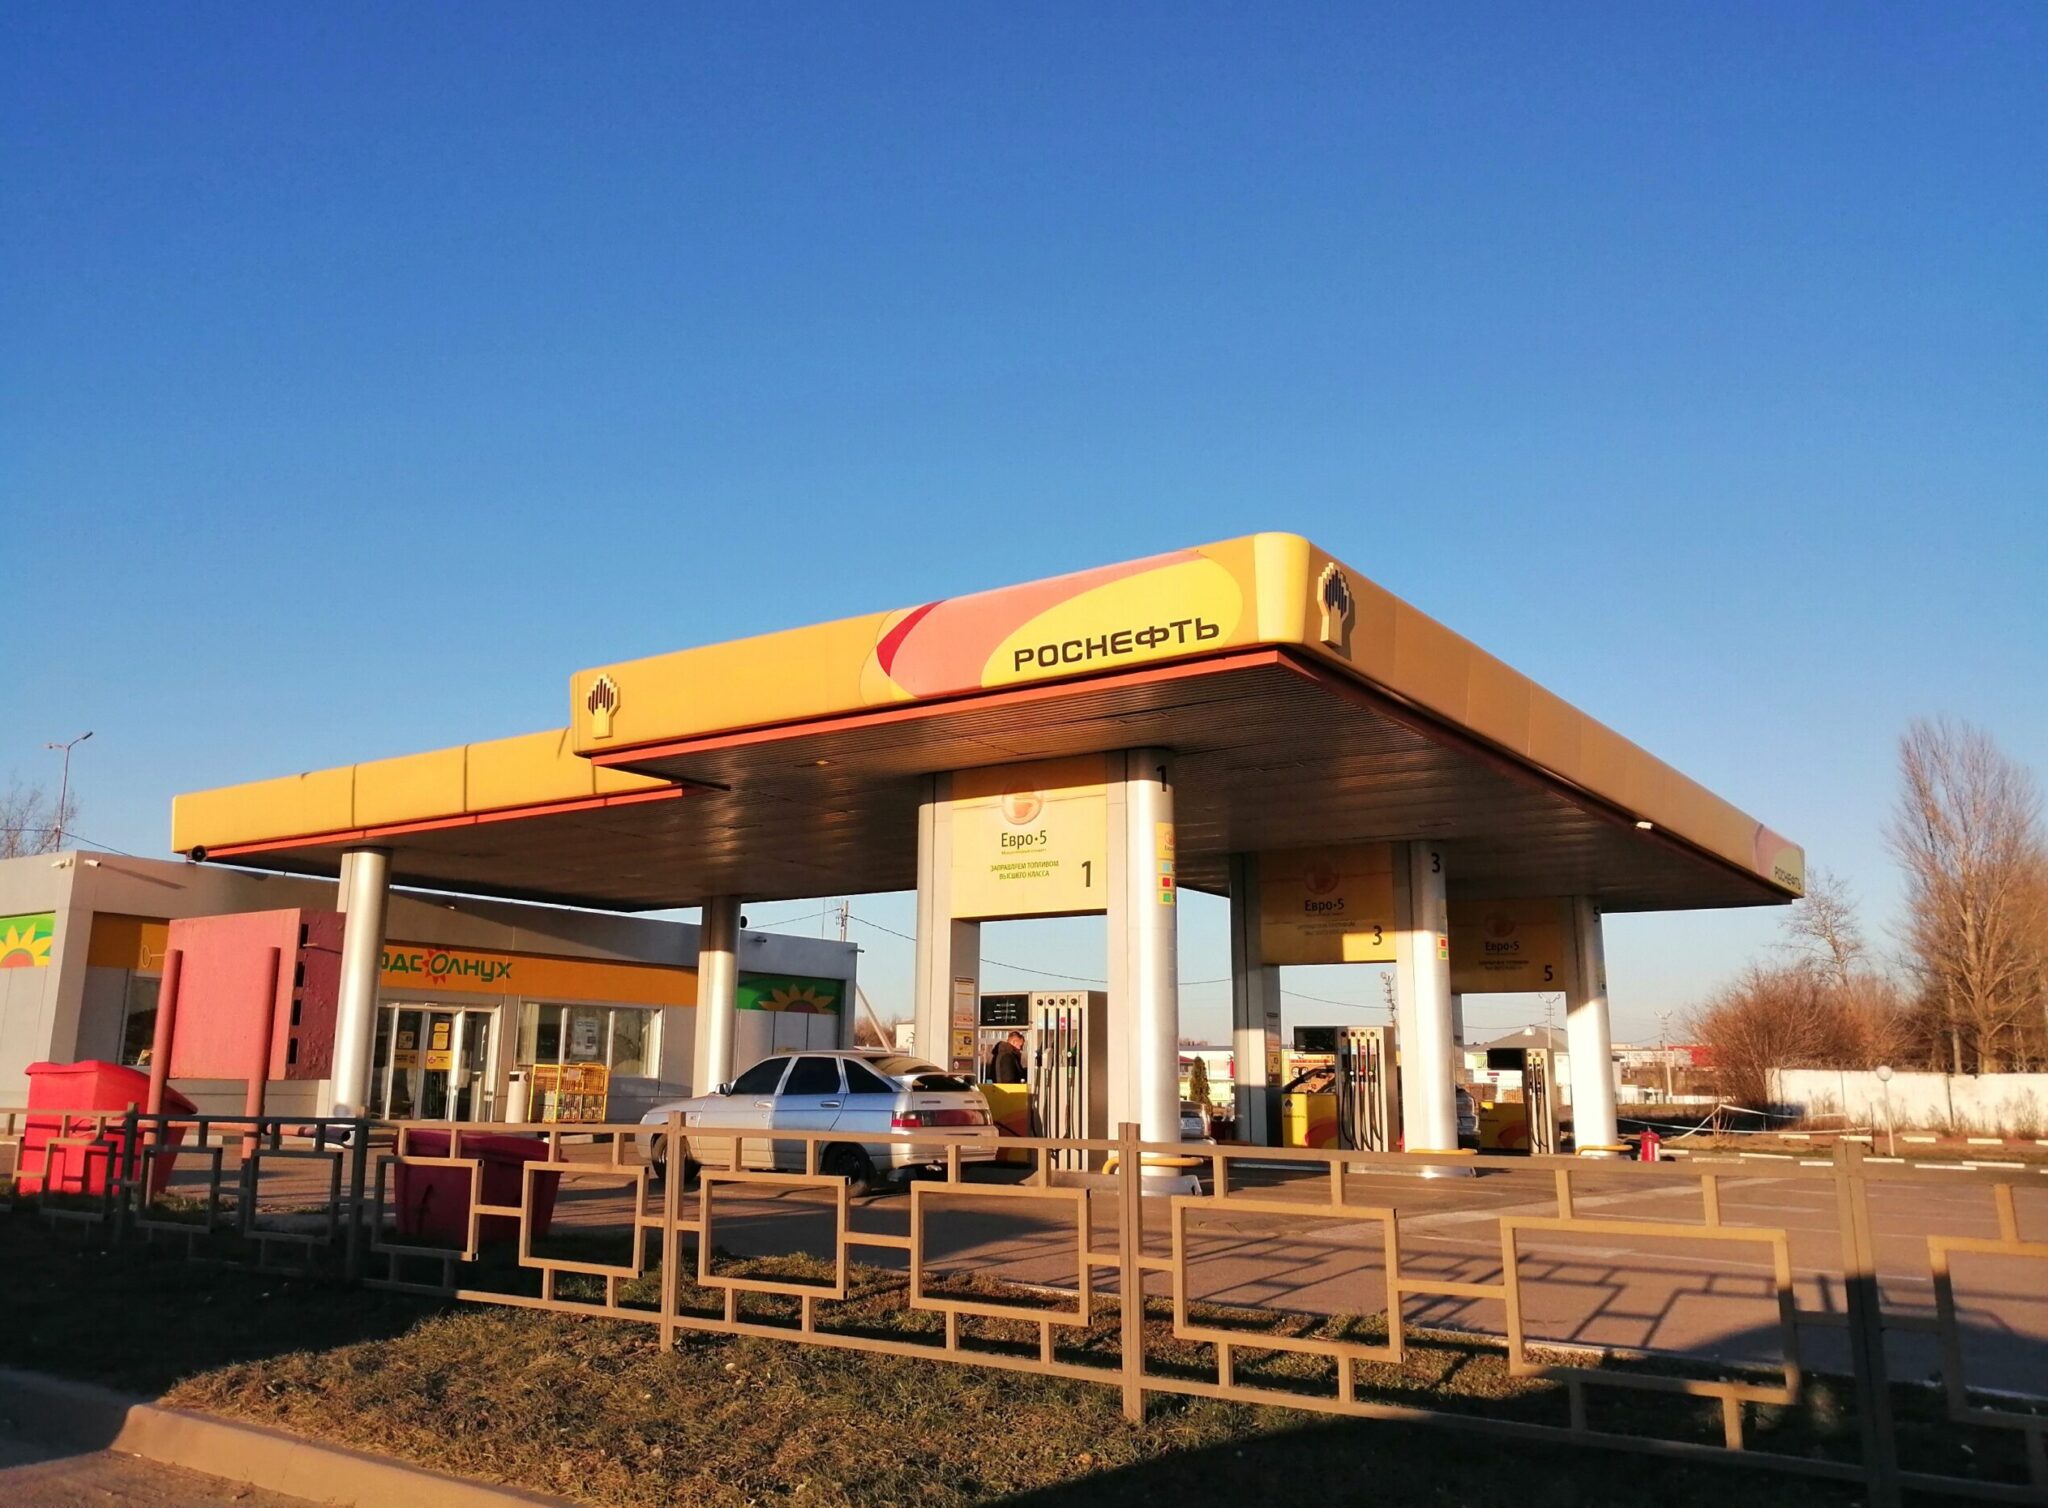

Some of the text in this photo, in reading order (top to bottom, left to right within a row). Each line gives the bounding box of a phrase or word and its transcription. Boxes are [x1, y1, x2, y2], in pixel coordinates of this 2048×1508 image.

[1014, 617, 1219, 672] РОСНЕФТЬ
[1156, 765, 1167, 792] 1
[1081, 860, 1092, 887] 1
[1431, 852, 1441, 873] 3
[1593, 906, 1600, 922] 5
[1372, 925, 1383, 946] 3
[381, 951, 512, 982] ОДСОЛНУХ
[1544, 965, 1553, 982] 5
